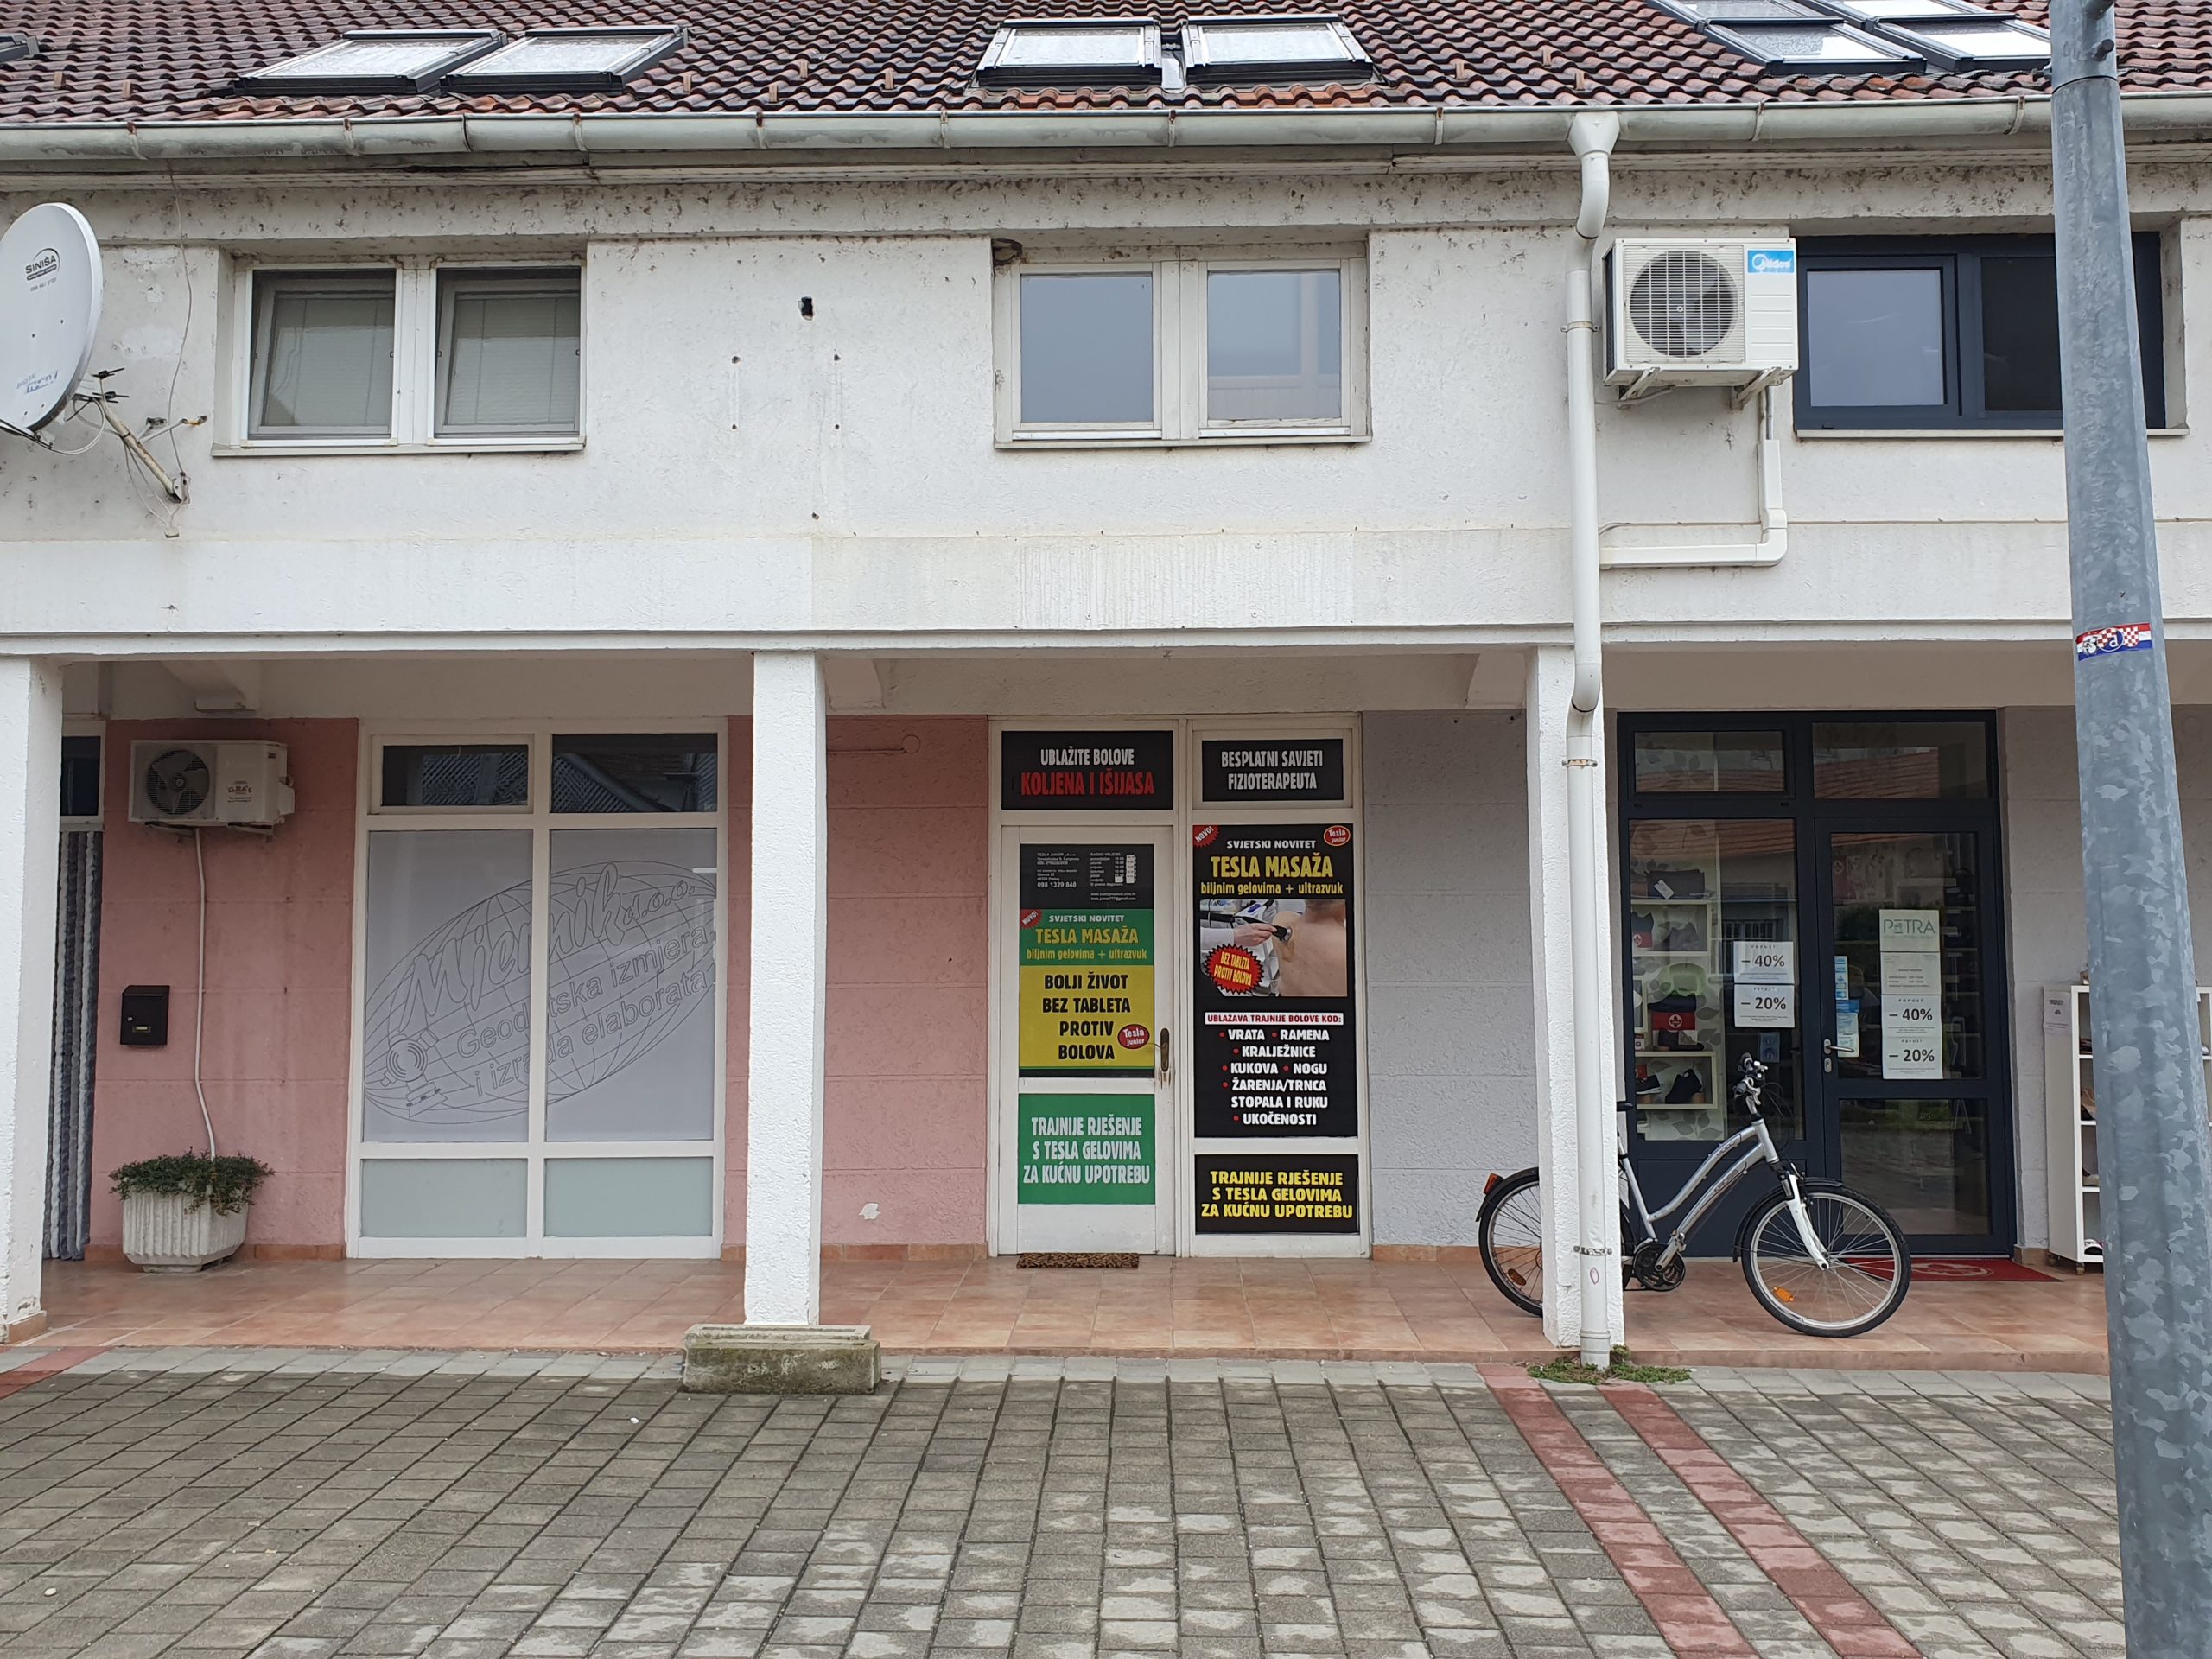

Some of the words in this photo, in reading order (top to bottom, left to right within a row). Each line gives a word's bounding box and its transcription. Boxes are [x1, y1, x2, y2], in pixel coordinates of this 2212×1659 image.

[1040, 746, 1090, 766] UBLAŽITE
[1093, 748, 1135, 766] BOLOVE
[1221, 751, 1279, 768] BESPLATNI
[1281, 750, 1323, 767] SAVJETI
[1020, 772, 1085, 796] KOLJENA
[1090, 772, 1095, 795] I
[1099, 767, 1154, 795] IŠIJASA
[1228, 772, 1317, 790] FIZIOTERAPEUTA
[1195, 825, 1214, 842] NOVO!
[1226, 840, 1271, 849] SVJETSKI
[1274, 840, 1316, 849] NOVITET
[1211, 855, 1260, 878] TESLA
[1265, 852, 1333, 877] MASAŽA
[1200, 881, 1235, 895] biljnim
[1237, 881, 1281, 895] gelovima
[1298, 881, 1343, 894] ultrazvuk
[623, 880, 695, 925] d.o.o.
[1022, 911, 1039, 925] NOVO!
[1884, 919, 1936, 933] PETRA
[1035, 928, 1077, 944] TESLA
[1081, 925, 1139, 944] MASAŽA
[1027, 948, 1055, 960] biljnim
[1058, 948, 1094, 961] gelovima
[1109, 948, 1147, 960] ultrazvuk
[1754, 955, 1785, 967] 40%
[1044, 975, 1083, 989] BOLJI
[1087, 971, 1128, 989] ŽIVOT
[457, 976, 603, 1058] Geodtska
[609, 926, 708, 988] izmjera
[1042, 998, 1068, 1013] BEZ
[1073, 998, 1131, 1013] TABLETA
[1755, 997, 1786, 1010] 20%
[1207, 1012, 1249, 1022] UBLAŽAVA
[1902, 1008, 1933, 1020] 40%
[475, 1071, 483, 1096] i
[582, 969, 708, 1045] elaborata
[1059, 1021, 1114, 1037] PROTIV
[1123, 1027, 1145, 1038] Tesla
[1228, 1029, 1265, 1040] VRATA
[1280, 1029, 1330, 1040] RAMENA
[1058, 1044, 1115, 1060] BOLOVA
[1242, 1044, 1316, 1058] KRALJEŽNICE
[1903, 1049, 1935, 1062] 20%
[1230, 1063, 1278, 1074] KUKOVA
[1294, 1063, 1328, 1074] NOGU
[1231, 1077, 1326, 1092] ŽARENJA/TRNCA
[1230, 1096, 1283, 1108] STOPALA
[1287, 1096, 1291, 1108] I
[1294, 1096, 1328, 1108] RUKU
[1032, 1117, 1084, 1135] TRAJNIJE
[1087, 1114, 1142, 1135] RJEŠENJE
[1243, 1111, 1317, 1125] UKOČENOSTI
[1033, 1141, 1040, 1160] S
[1044, 1141, 1079, 1160] TESLA
[1082, 1141, 1141, 1160] GELOVIMA
[1023, 1165, 1038, 1184] ZA
[1042, 1161, 1081, 1184] KUĆNU
[1085, 1165, 1150, 1184] UPOTREBU
[1210, 1171, 1273, 1185] TRAJNIJE
[1277, 1169, 1343, 1185] RJEŠENJE
[1212, 1187, 1221, 1200] S
[1225, 1187, 1268, 1201] TESLA
[1271, 1188, 1342, 1202] GELOVIMA
[1201, 1204, 1219, 1217] ZA
[1223, 1201, 1270, 1217] KUĆNU
[1274, 1205, 1353, 1218] UPOTREBU
